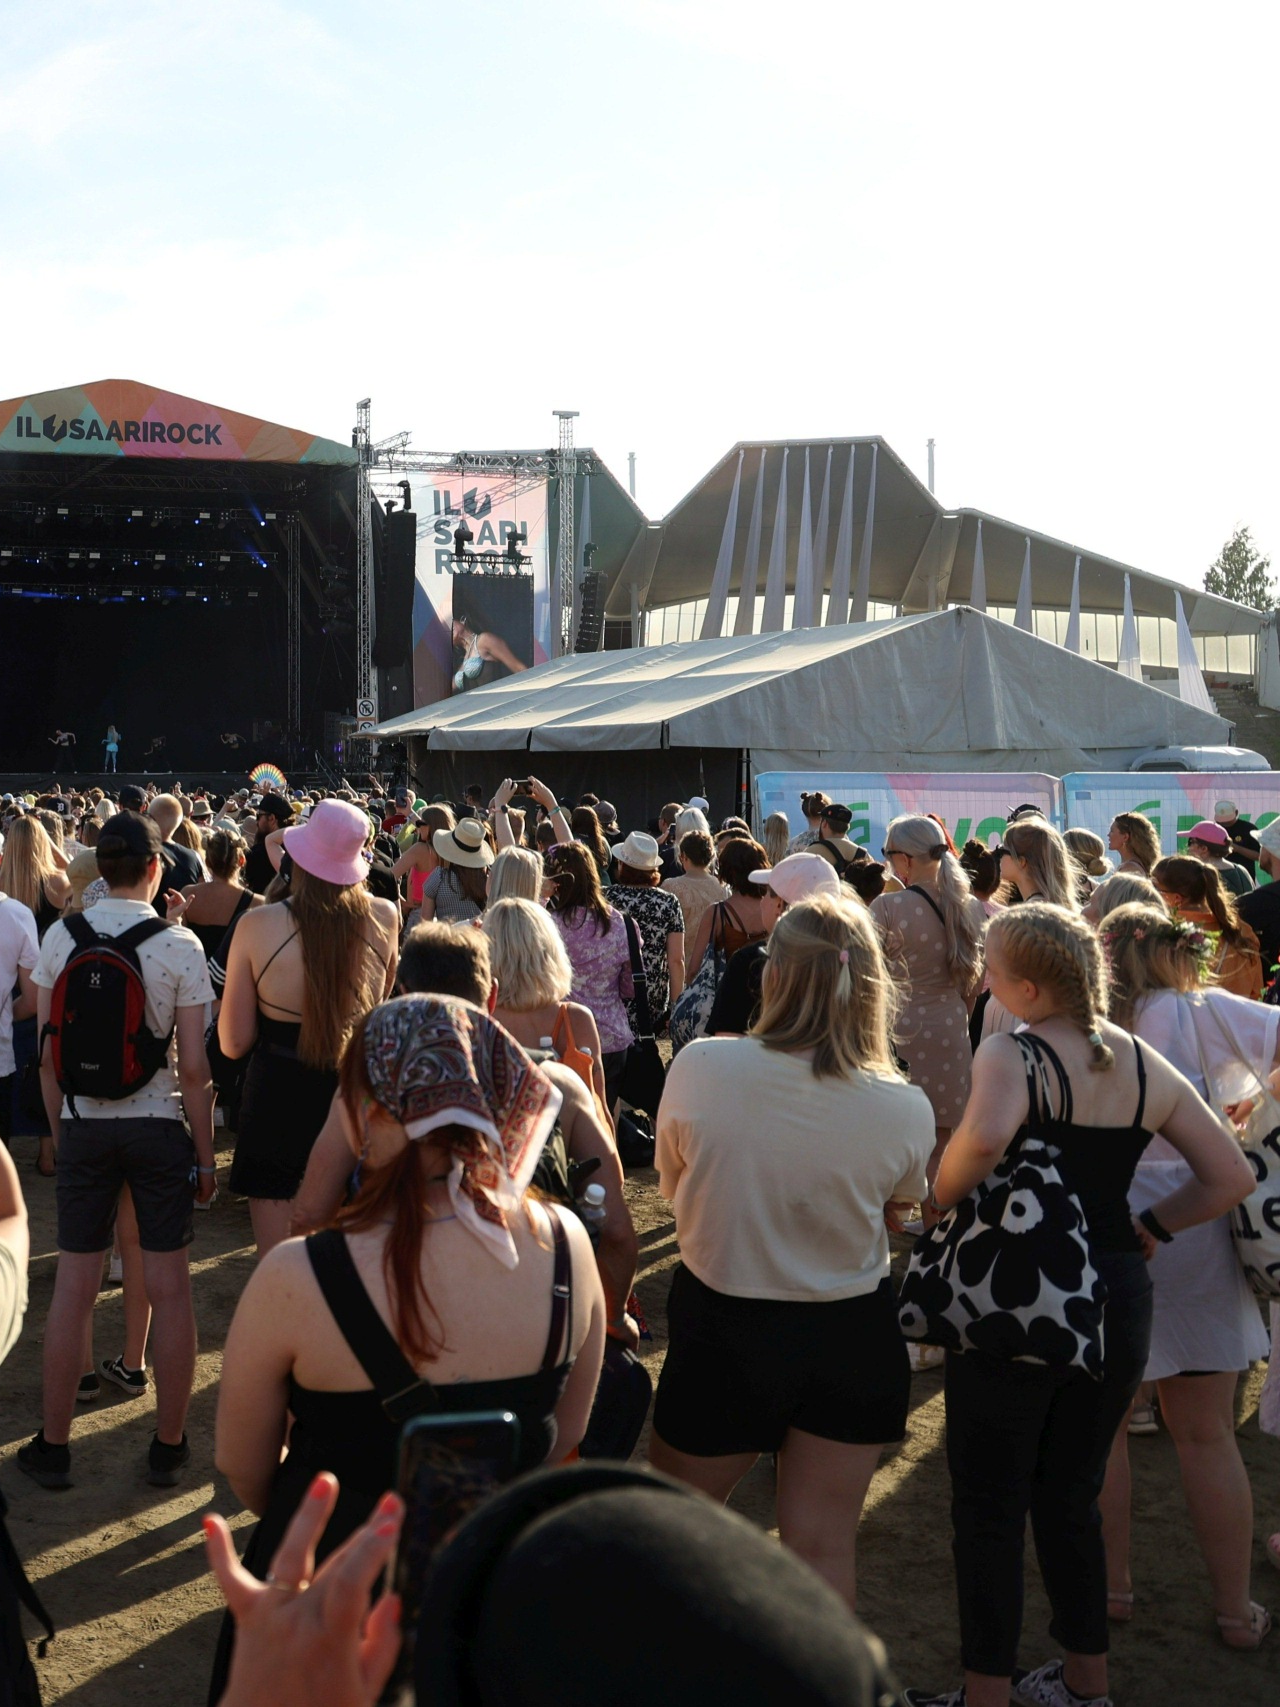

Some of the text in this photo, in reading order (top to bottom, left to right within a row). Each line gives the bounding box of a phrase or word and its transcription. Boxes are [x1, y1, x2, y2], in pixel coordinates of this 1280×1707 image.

[434, 520, 528, 546] SAARI
[435, 549, 524, 575] ROCK
[80, 1062, 100, 1070] TIGHT
